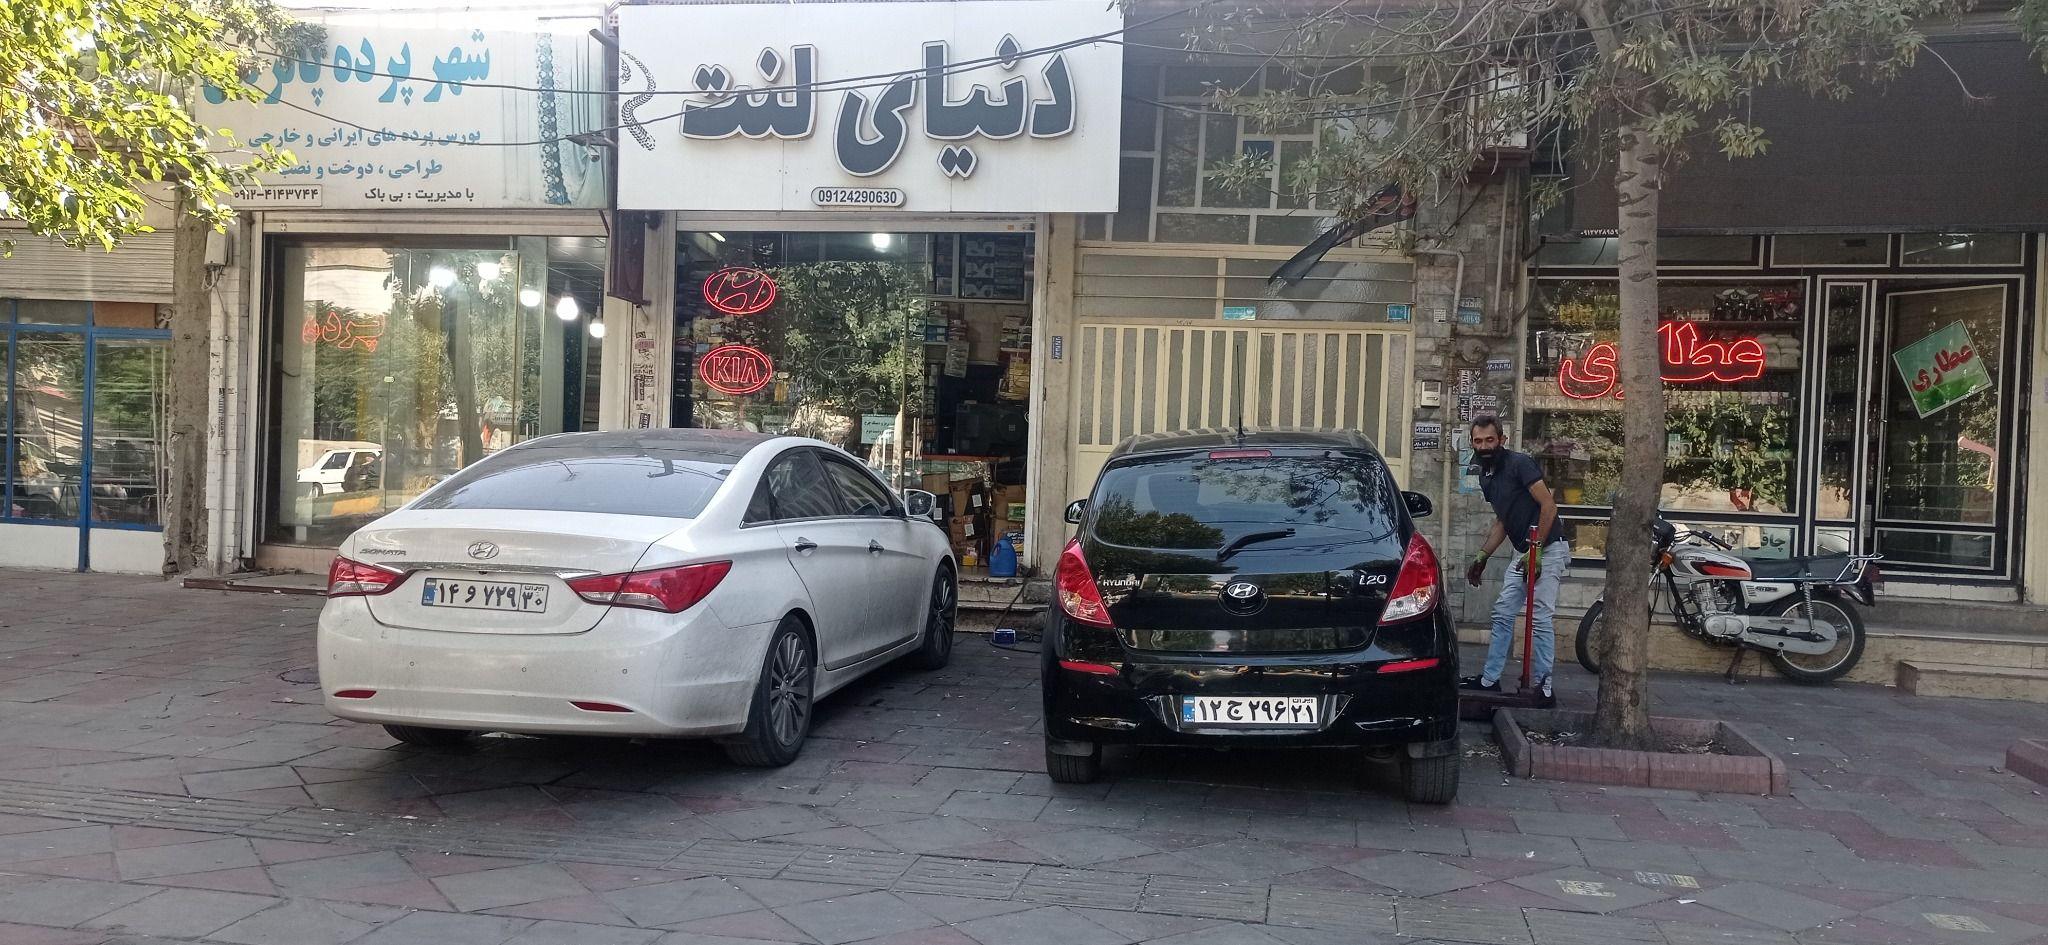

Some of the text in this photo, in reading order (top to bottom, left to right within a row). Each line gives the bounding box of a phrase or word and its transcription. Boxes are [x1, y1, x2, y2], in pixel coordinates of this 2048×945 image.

[333, 37, 412, 107] پرده
[423, 28, 490, 103] شهر
[678, 32, 1080, 180] دنیای لنت
[248, 127, 481, 149] بورس پرده های ایرانی و خارجی
[279, 159, 312, 179] نصب
[315, 164, 324, 179] و
[327, 160, 374, 180] دوخت
[388, 159, 443, 180] طراحی
[364, 187, 385, 202] باک
[389, 191, 403, 203] بی
[415, 188, 462, 202] مدیریت
[465, 187, 475, 202] با
[818, 189, 898, 204] 09124290630
[302, 310, 385, 353] پرده
[712, 356, 760, 384] KIA
[1560, 322, 1766, 399] عطای
[1911, 344, 1974, 393] عطاری
[359, 548, 407, 557] SONATA
[1102, 579, 1141, 587] HYUNDAI
[1358, 574, 1387, 586] i20
[438, 582, 460, 604] ۱۴
[483, 584, 517, 608] ۷۲۹
[1198, 699, 1222, 721] ۱۲
[1248, 699, 1287, 722] ۲۹۶
